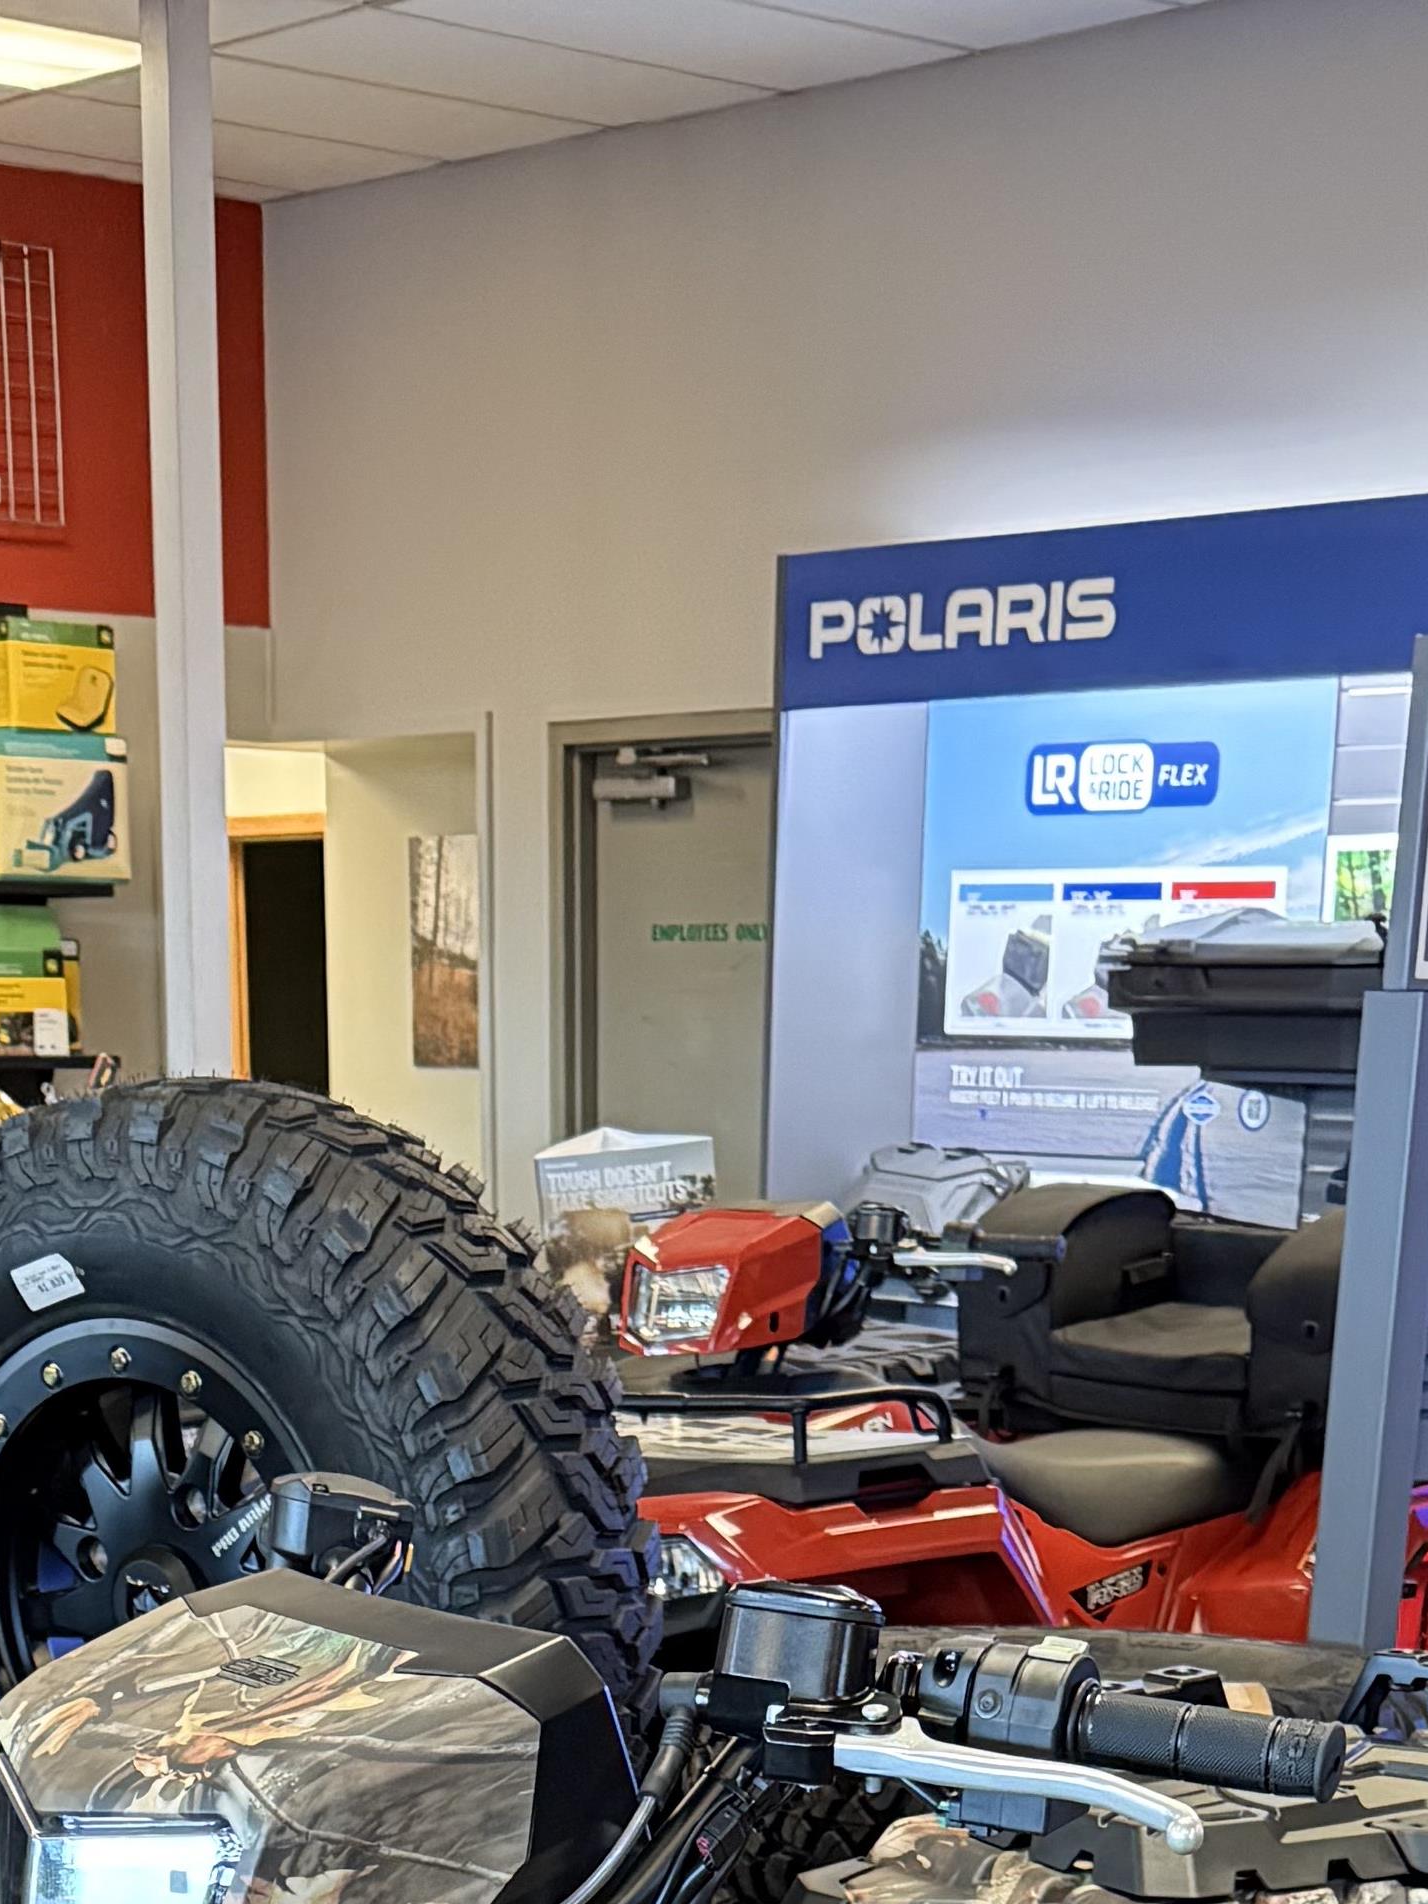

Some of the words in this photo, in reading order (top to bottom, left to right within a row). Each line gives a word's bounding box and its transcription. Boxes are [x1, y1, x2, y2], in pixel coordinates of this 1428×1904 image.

[809, 576, 1117, 659] POLARIS
[1089, 753, 1144, 775] LOCK
[1157, 763, 1209, 787] FLEX
[652, 923, 728, 941] EMPLOYEES
[950, 1065, 977, 1087] TRY
[546, 1168, 601, 1193] TOUGH
[603, 1161, 672, 1188] DOESN'T
